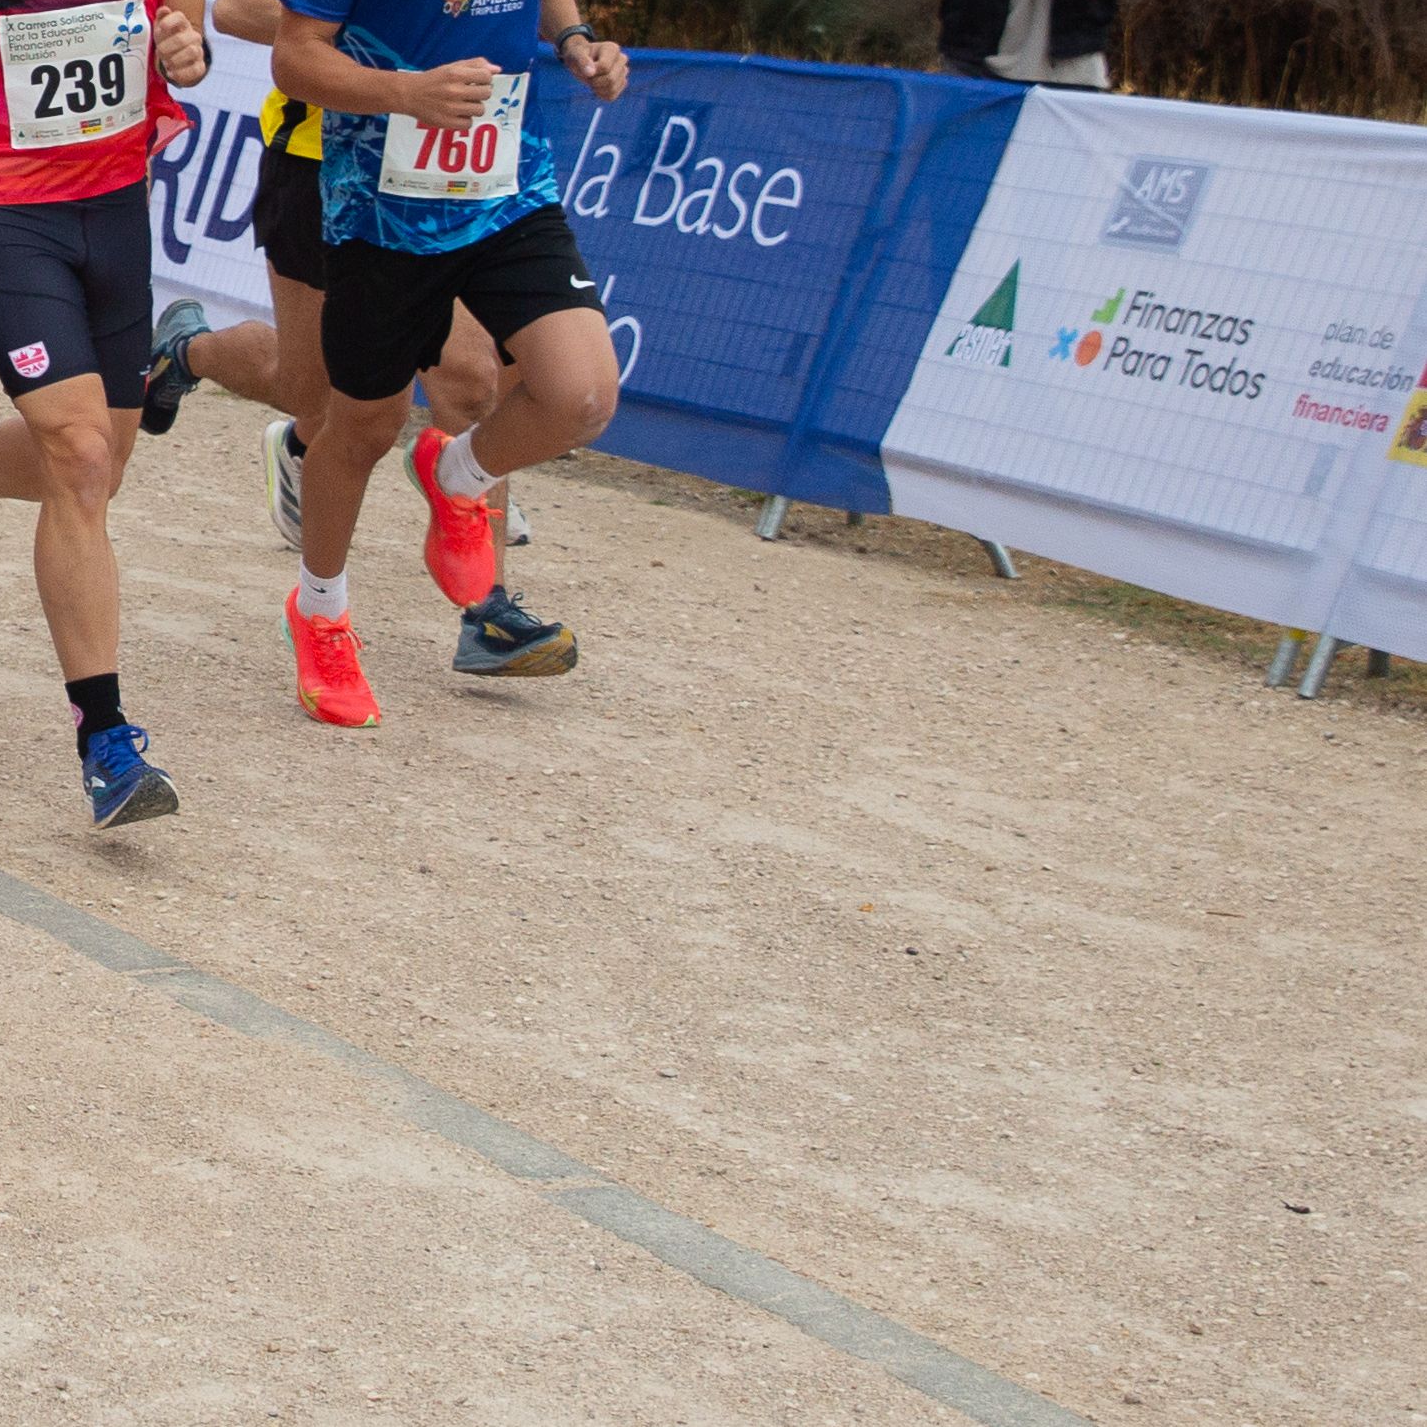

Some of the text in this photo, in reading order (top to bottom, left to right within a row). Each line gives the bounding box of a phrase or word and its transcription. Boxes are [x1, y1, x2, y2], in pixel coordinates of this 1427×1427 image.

[7, 12, 104, 31] X Carrera Solidaria
[471, 2, 524, 16] TRIPLE ZERO
[8, 24, 96, 42] por la Educación
[9, 38, 63, 52] Financiera
[75, 35, 84, 44] la
[10, 49, 56, 62] Inclusión
[31, 53, 125, 119] 239
[414, 120, 498, 174] 760
[150, 101, 263, 265] RID
[562, 106, 803, 246] la Base
[1136, 167, 1193, 204] AMS
[1123, 291, 1254, 346] Finanzas
[1323, 321, 1394, 349] plan de
[1103, 336, 1265, 400] Para Todos
[1309, 358, 1414, 393] educación
[1292, 394, 1389, 432] financiera
